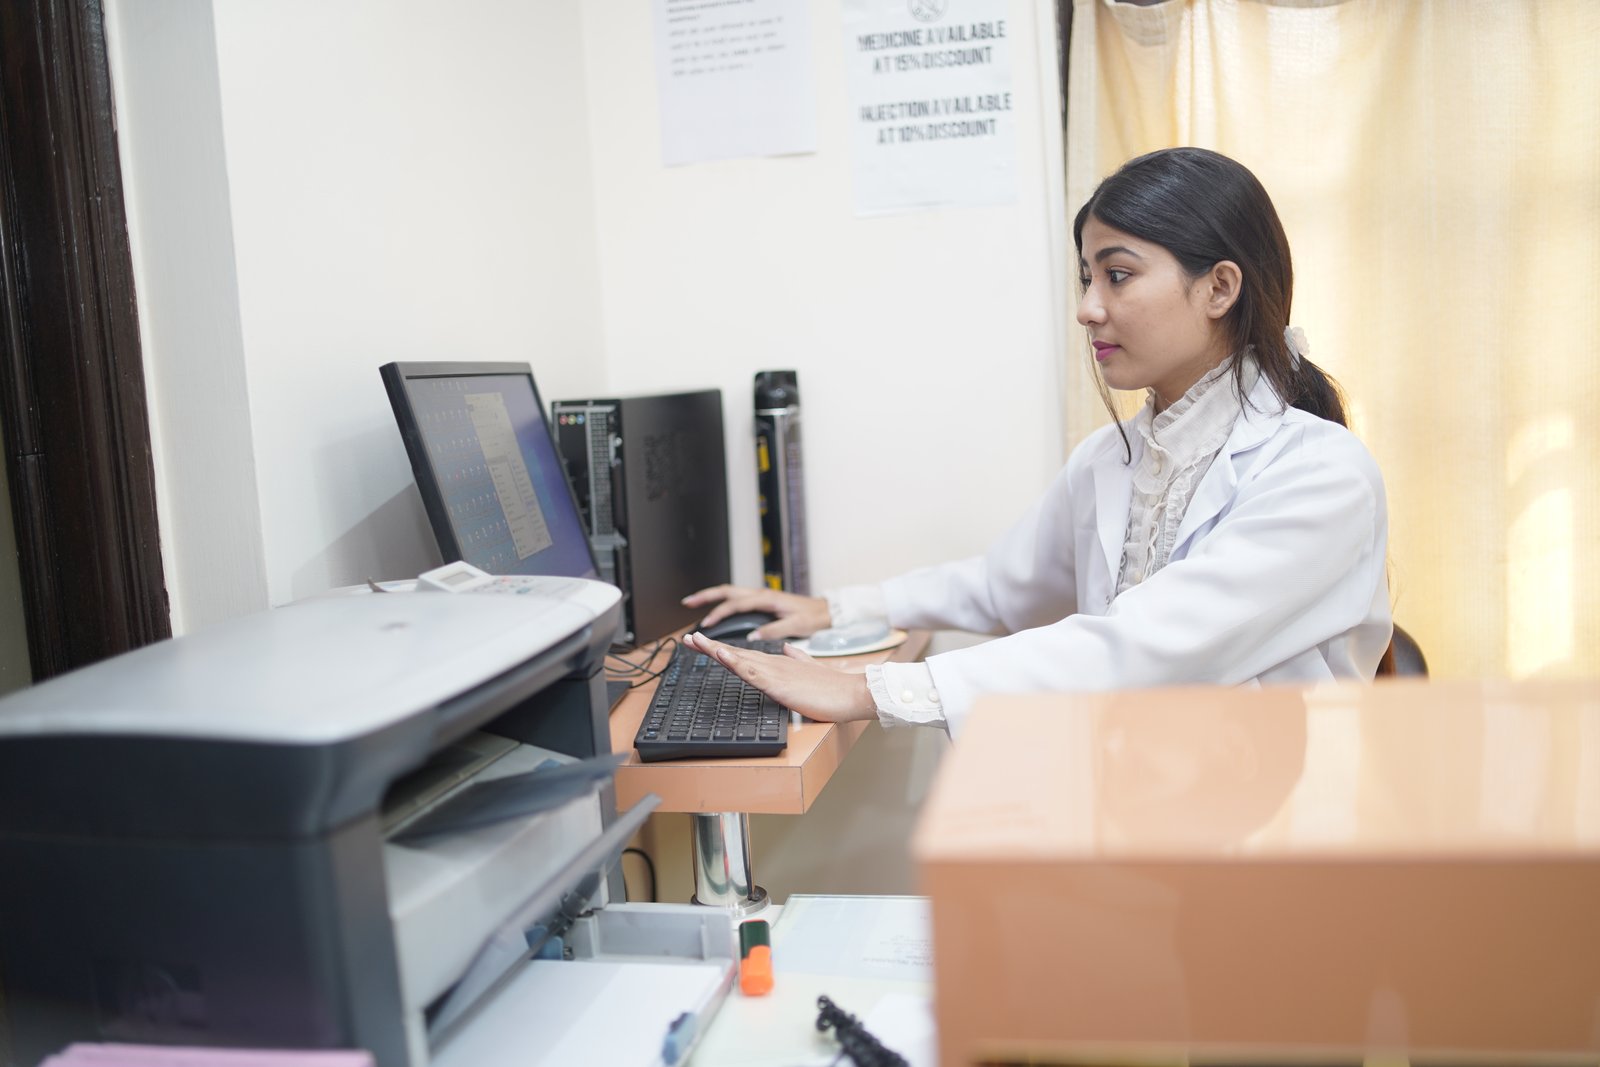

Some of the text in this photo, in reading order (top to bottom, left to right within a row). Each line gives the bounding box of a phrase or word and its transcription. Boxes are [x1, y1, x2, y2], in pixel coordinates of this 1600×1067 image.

[858, 21, 1005, 50] MEDICINE AVAILABLE
[874, 56, 890, 73] AT
[924, 47, 992, 68] DISCOUNT
[933, 93, 1011, 115] AVAILABLE
[879, 127, 894, 144] AT
[928, 119, 996, 139] DISCOUNT
